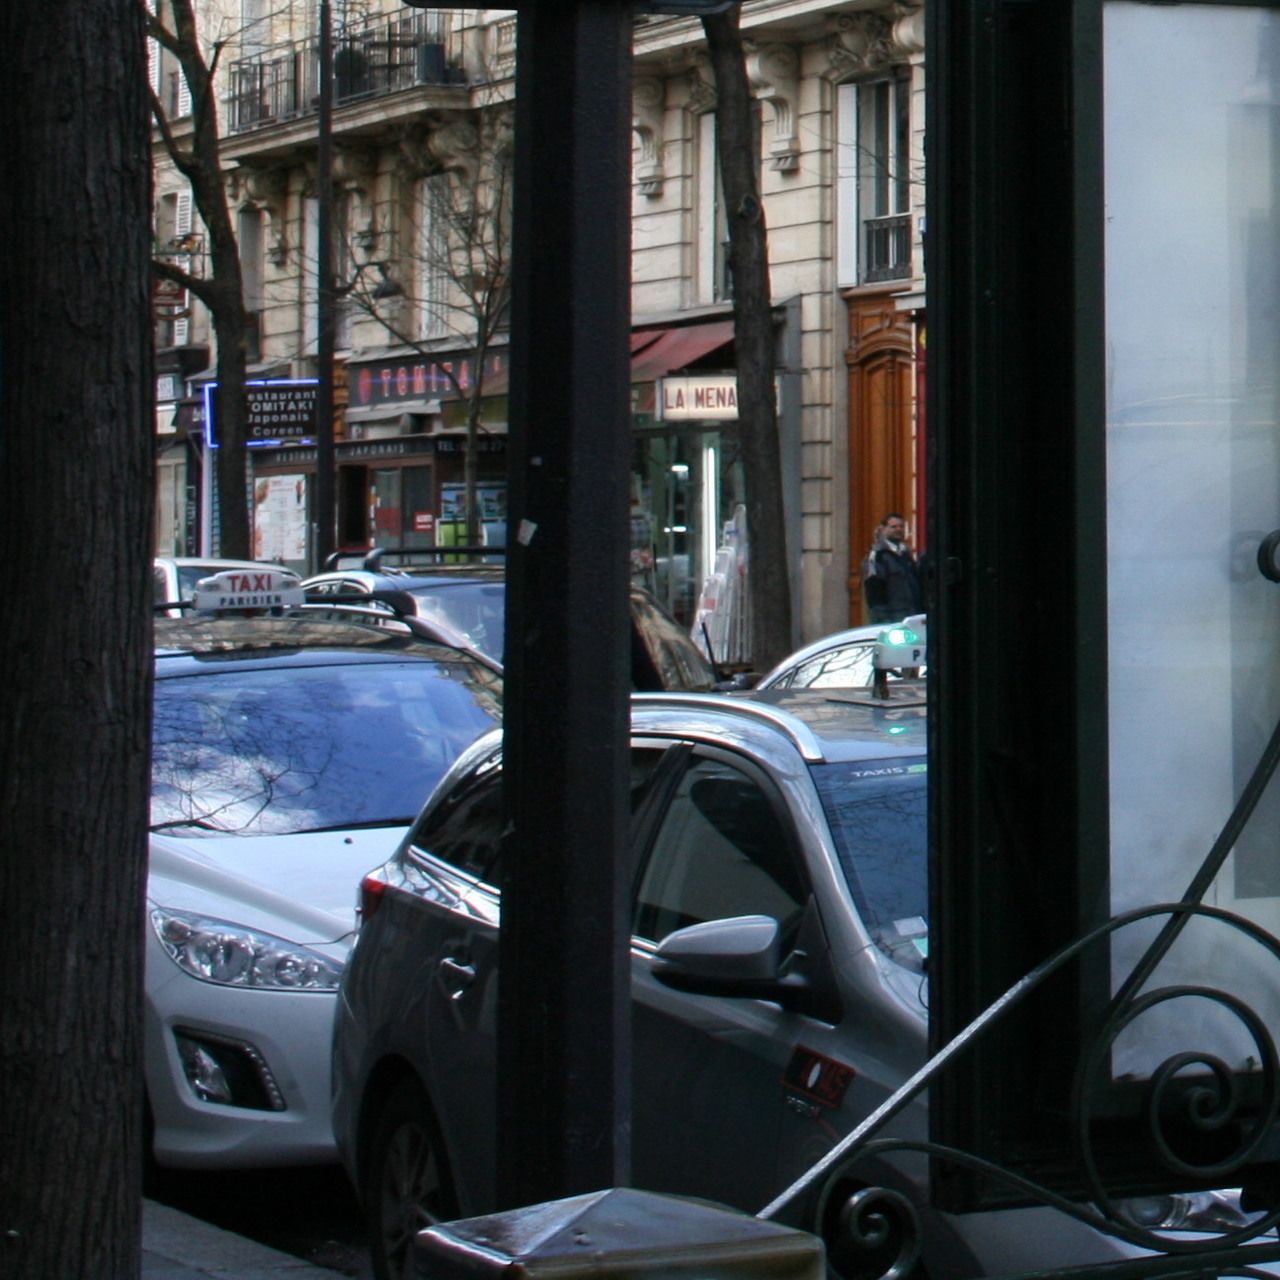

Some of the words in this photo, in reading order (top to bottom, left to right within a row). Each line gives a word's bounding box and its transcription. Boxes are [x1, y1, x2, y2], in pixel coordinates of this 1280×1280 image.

[247, 390, 317, 401] estaurant
[664, 388, 685, 409] LA
[246, 401, 313, 412] OMITAKI
[227, 574, 272, 592] TAXI
[220, 595, 282, 606] PARISIEN
[851, 768, 904, 778] TAXIS
